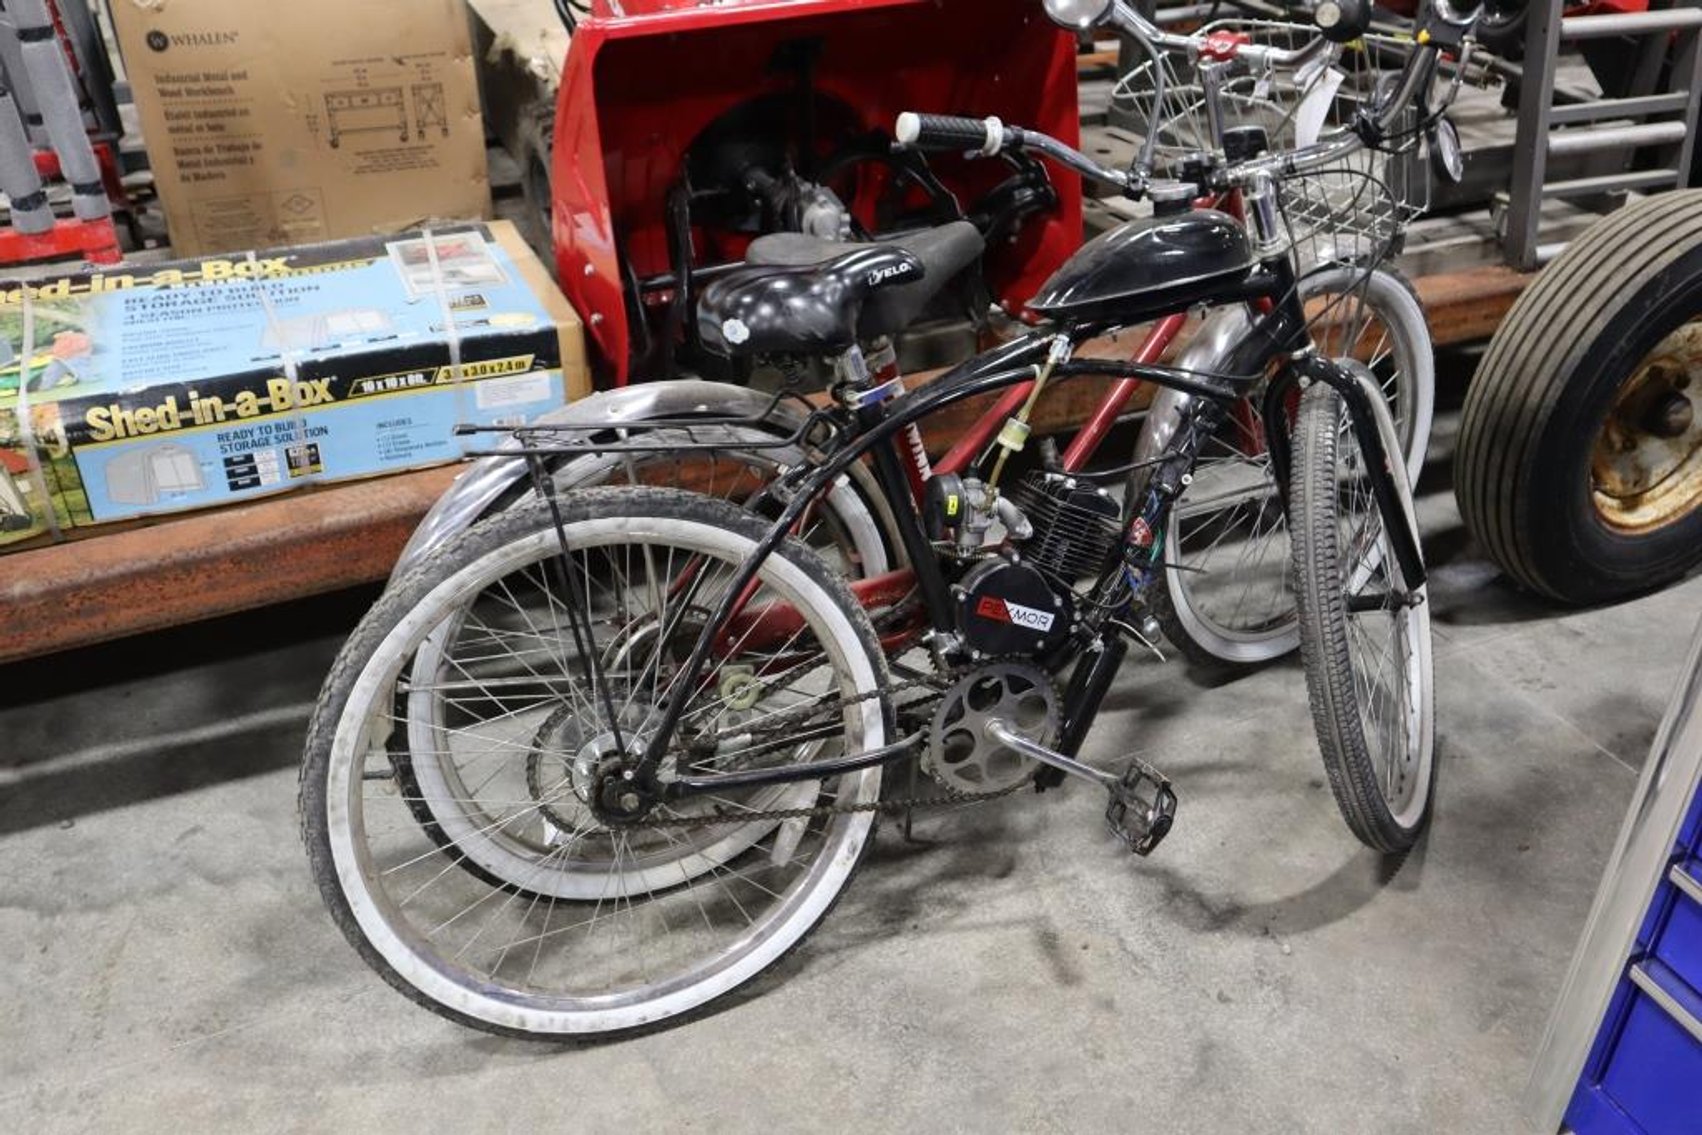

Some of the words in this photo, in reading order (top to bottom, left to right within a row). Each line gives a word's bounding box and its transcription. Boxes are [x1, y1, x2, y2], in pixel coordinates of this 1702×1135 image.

[362, 380, 375, 393] 10
[384, 377, 398, 389] 10
[86, 377, 334, 441] Shed-in-a-Box
[217, 427, 254, 443] READY
[256, 424, 272, 436] TO
[219, 437, 271, 454] STORAGE
[274, 425, 329, 444] SOLTION
